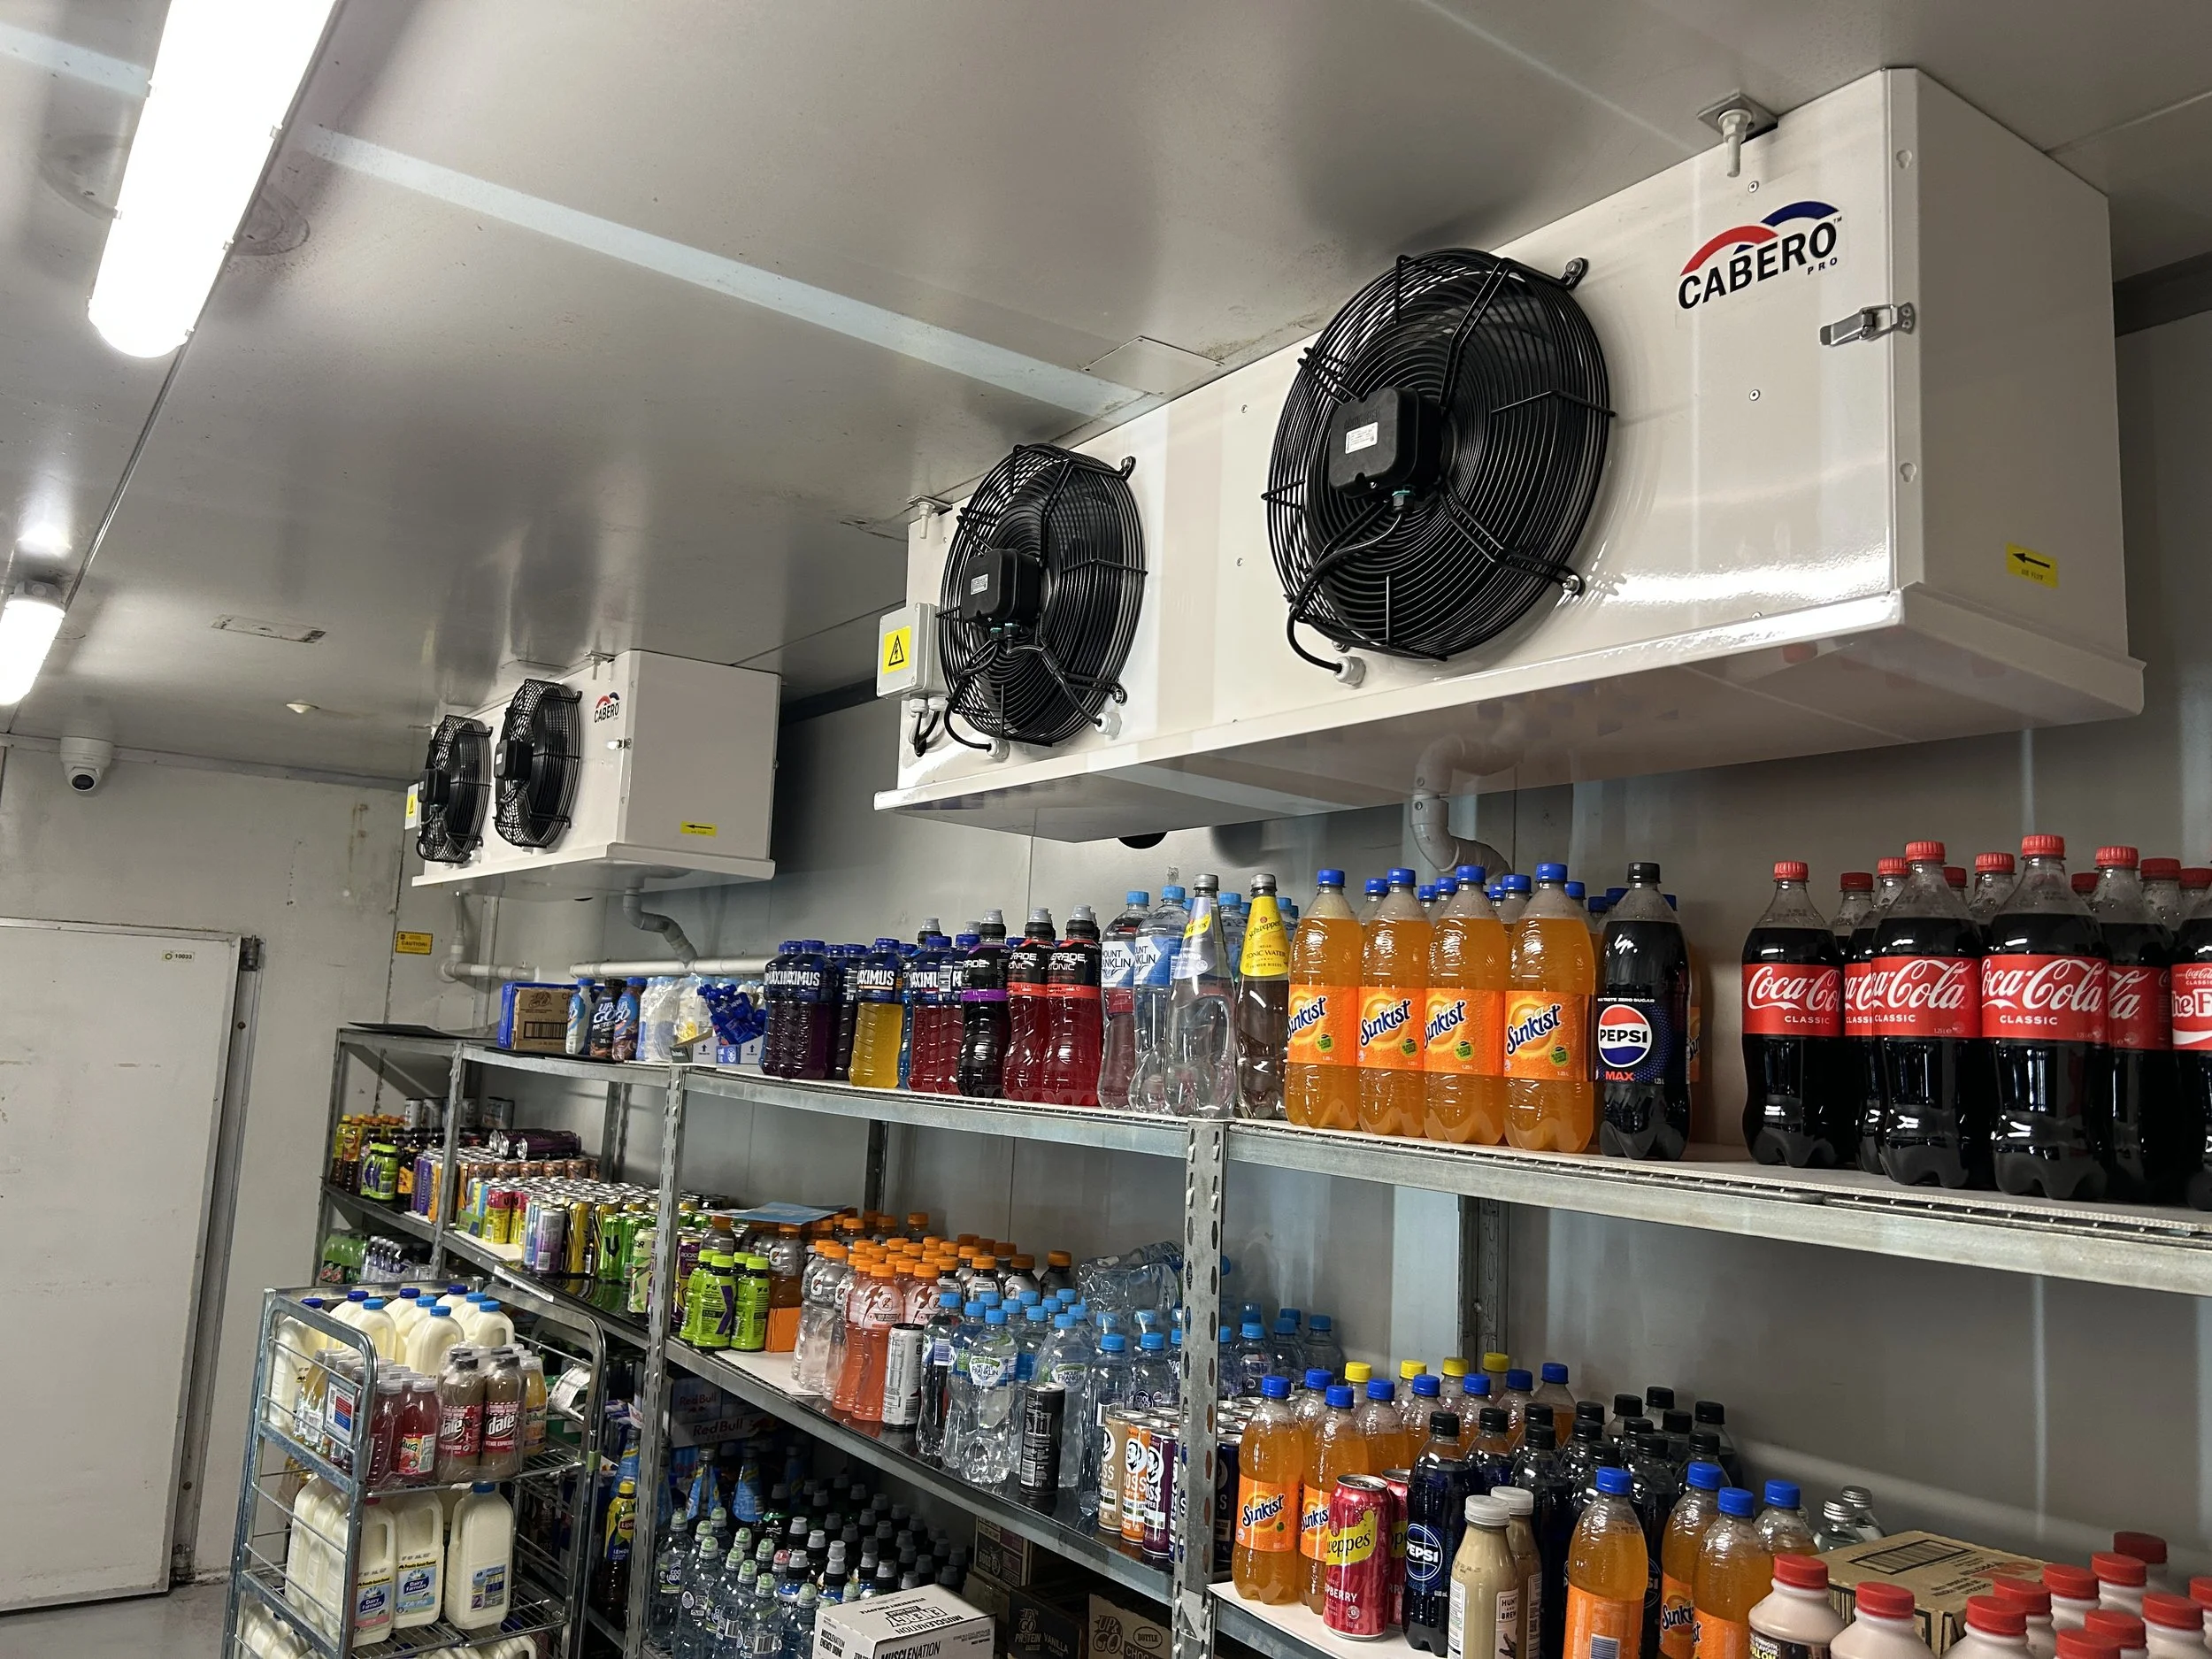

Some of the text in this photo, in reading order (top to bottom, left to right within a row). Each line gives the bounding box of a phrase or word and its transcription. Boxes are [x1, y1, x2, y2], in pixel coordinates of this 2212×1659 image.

[1678, 221, 1837, 310] CABERO
[1807, 257, 1838, 275] PRO
[594, 702, 619, 724] CABERO
[1102, 958, 1132, 968] ANKLIN
[1135, 955, 1156, 965] NKLIN
[786, 971, 820, 987] AXIMUS
[857, 969, 895, 987] AXIMUS
[910, 972, 940, 988] AXIMU
[1747, 965, 1842, 1012] Coca-Col
[2172, 990, 2194, 1018] he
[1360, 999, 1411, 1047] Sunkist
[1784, 1015, 1830, 1025] CLASSIC
[1874, 1013, 1916, 1023] CLASSIC
[1999, 1015, 2058, 1025] CLASSIC
[1507, 1003, 1562, 1055] Sunkist
[1600, 1028, 1648, 1044] PEPSI
[1605, 1071, 1635, 1081] MAX
[972, 1367, 999, 1377] FRANKLIN
[680, 1391, 717, 1407] Red Bull
[488, 1415, 515, 1436] dare
[693, 1417, 743, 1437] Red Bull
[1125, 1472, 1147, 1492] OSS
[1146, 1484, 1162, 1502] OSS
[1242, 1494, 1285, 1527] Sunkist
[1302, 1506, 1329, 1532] unkis
[1327, 1531, 1371, 1558] eppes
[1407, 1542, 1439, 1563] PEPSI
[362, 1601, 382, 1610] Farmers
[886, 1607, 948, 1627] ENERGY
[895, 1615, 964, 1635] MUSCLENATION
[1019, 1618, 1037, 1632] GO
[1098, 1615, 1119, 1632] UP&
[1661, 1603, 1694, 1632] Sunki
[821, 1628, 846, 1648] MUSCLENATION
[1015, 1633, 1041, 1644] PROTEIN
[1043, 1632, 1069, 1654] VANILLA
[1093, 1632, 1123, 1653] GO
[1137, 1632, 1159, 1642] BOTTLE
[819, 1637, 843, 1659] ENERGY DRINK
[881, 1640, 941, 1659] MUSCLENATION
